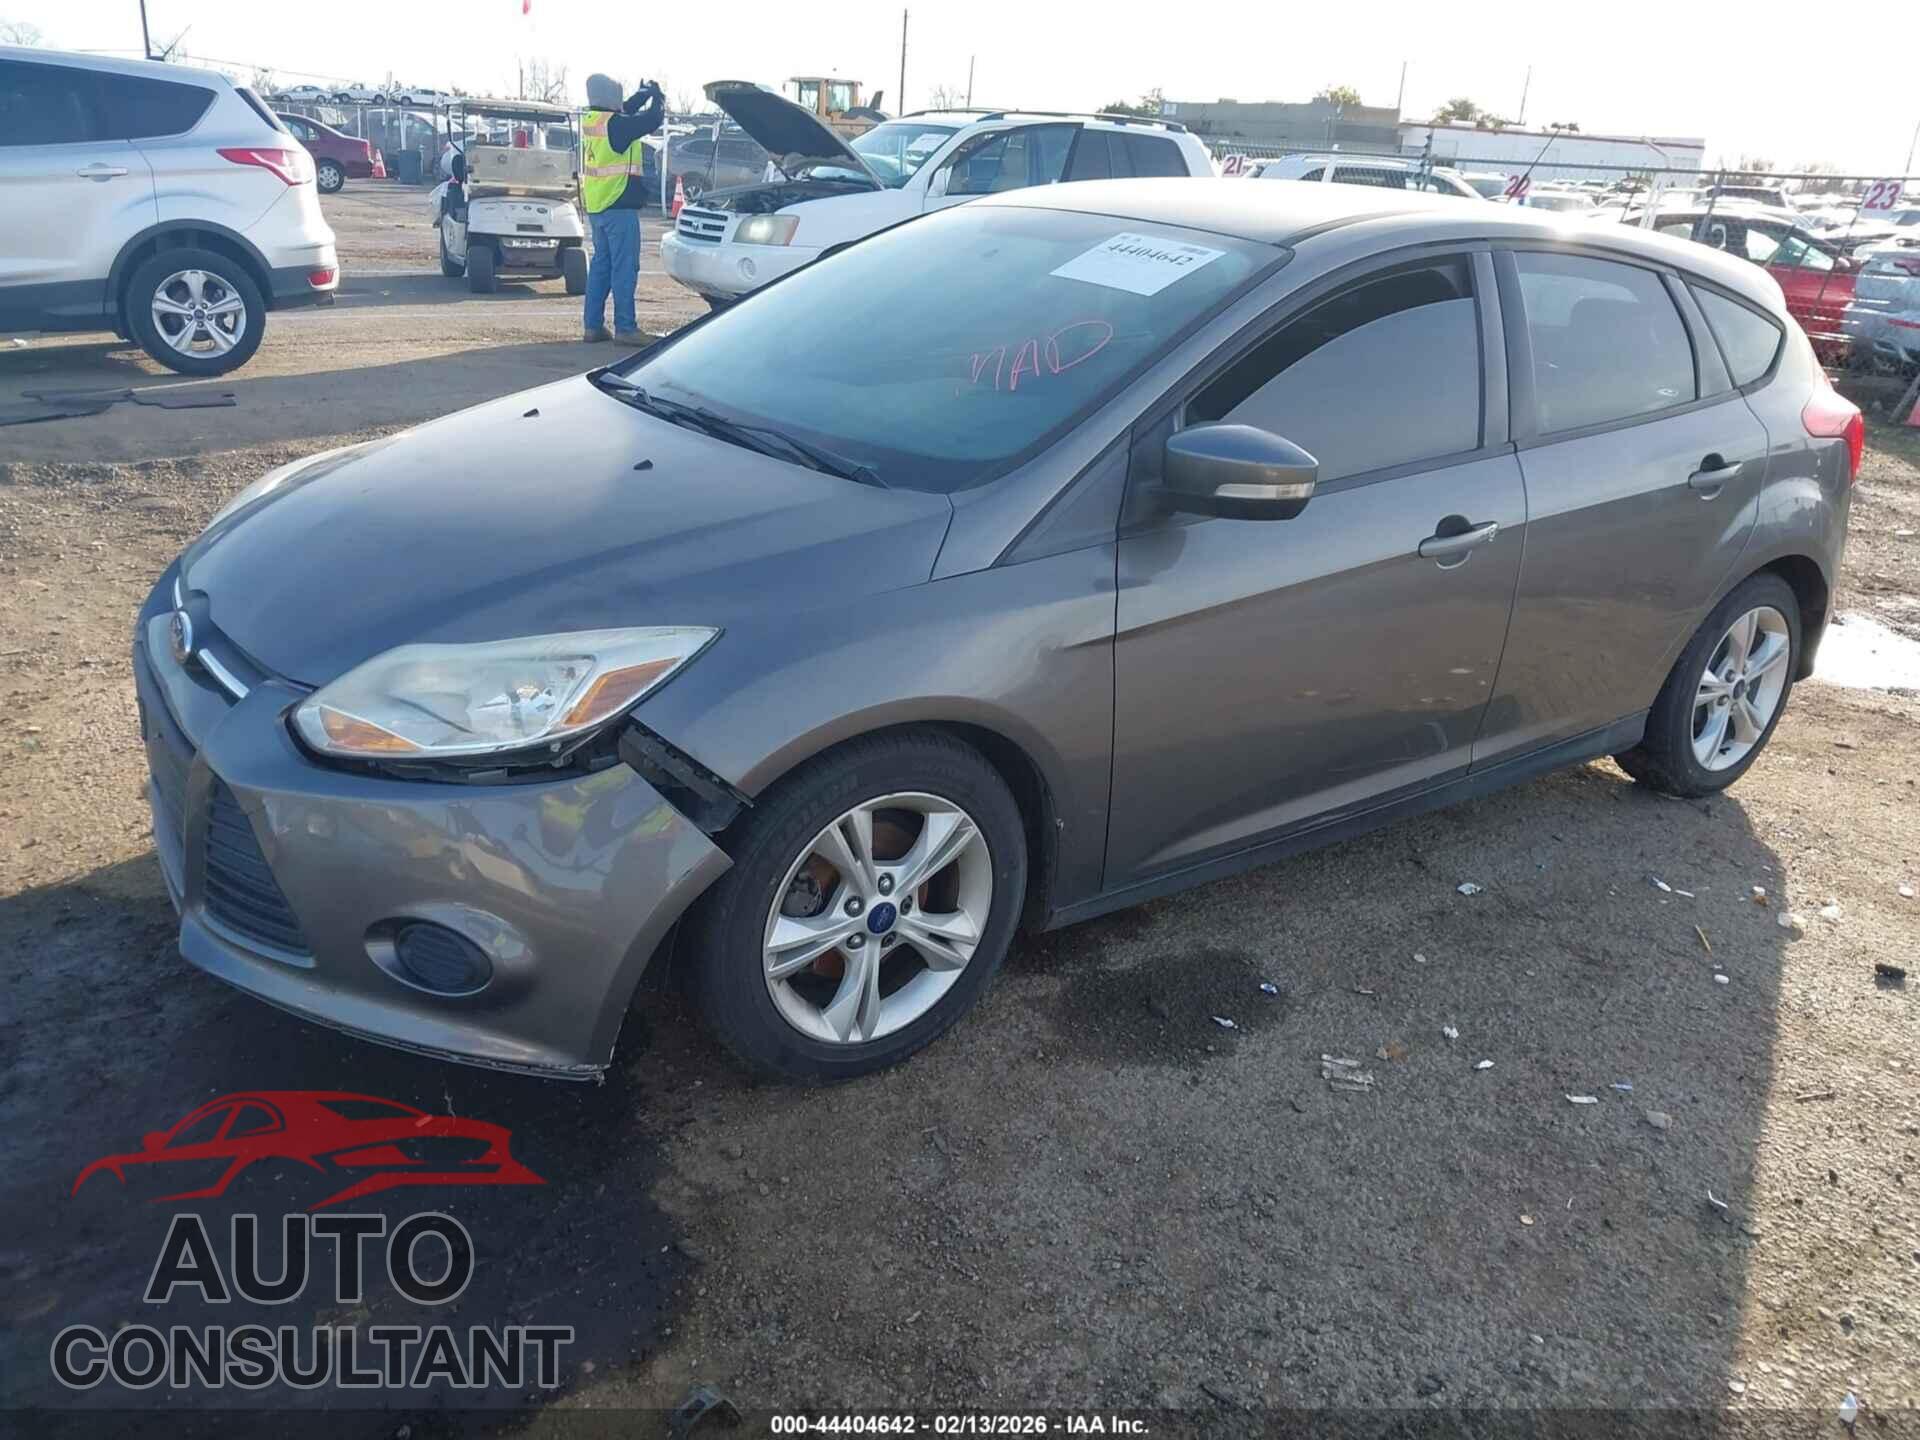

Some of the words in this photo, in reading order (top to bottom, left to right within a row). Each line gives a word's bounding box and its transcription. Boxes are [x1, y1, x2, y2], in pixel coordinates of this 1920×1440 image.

[1223, 155, 1244, 175] 21
[1864, 182, 1901, 210] 23
[1107, 243, 1194, 266] 44404642
